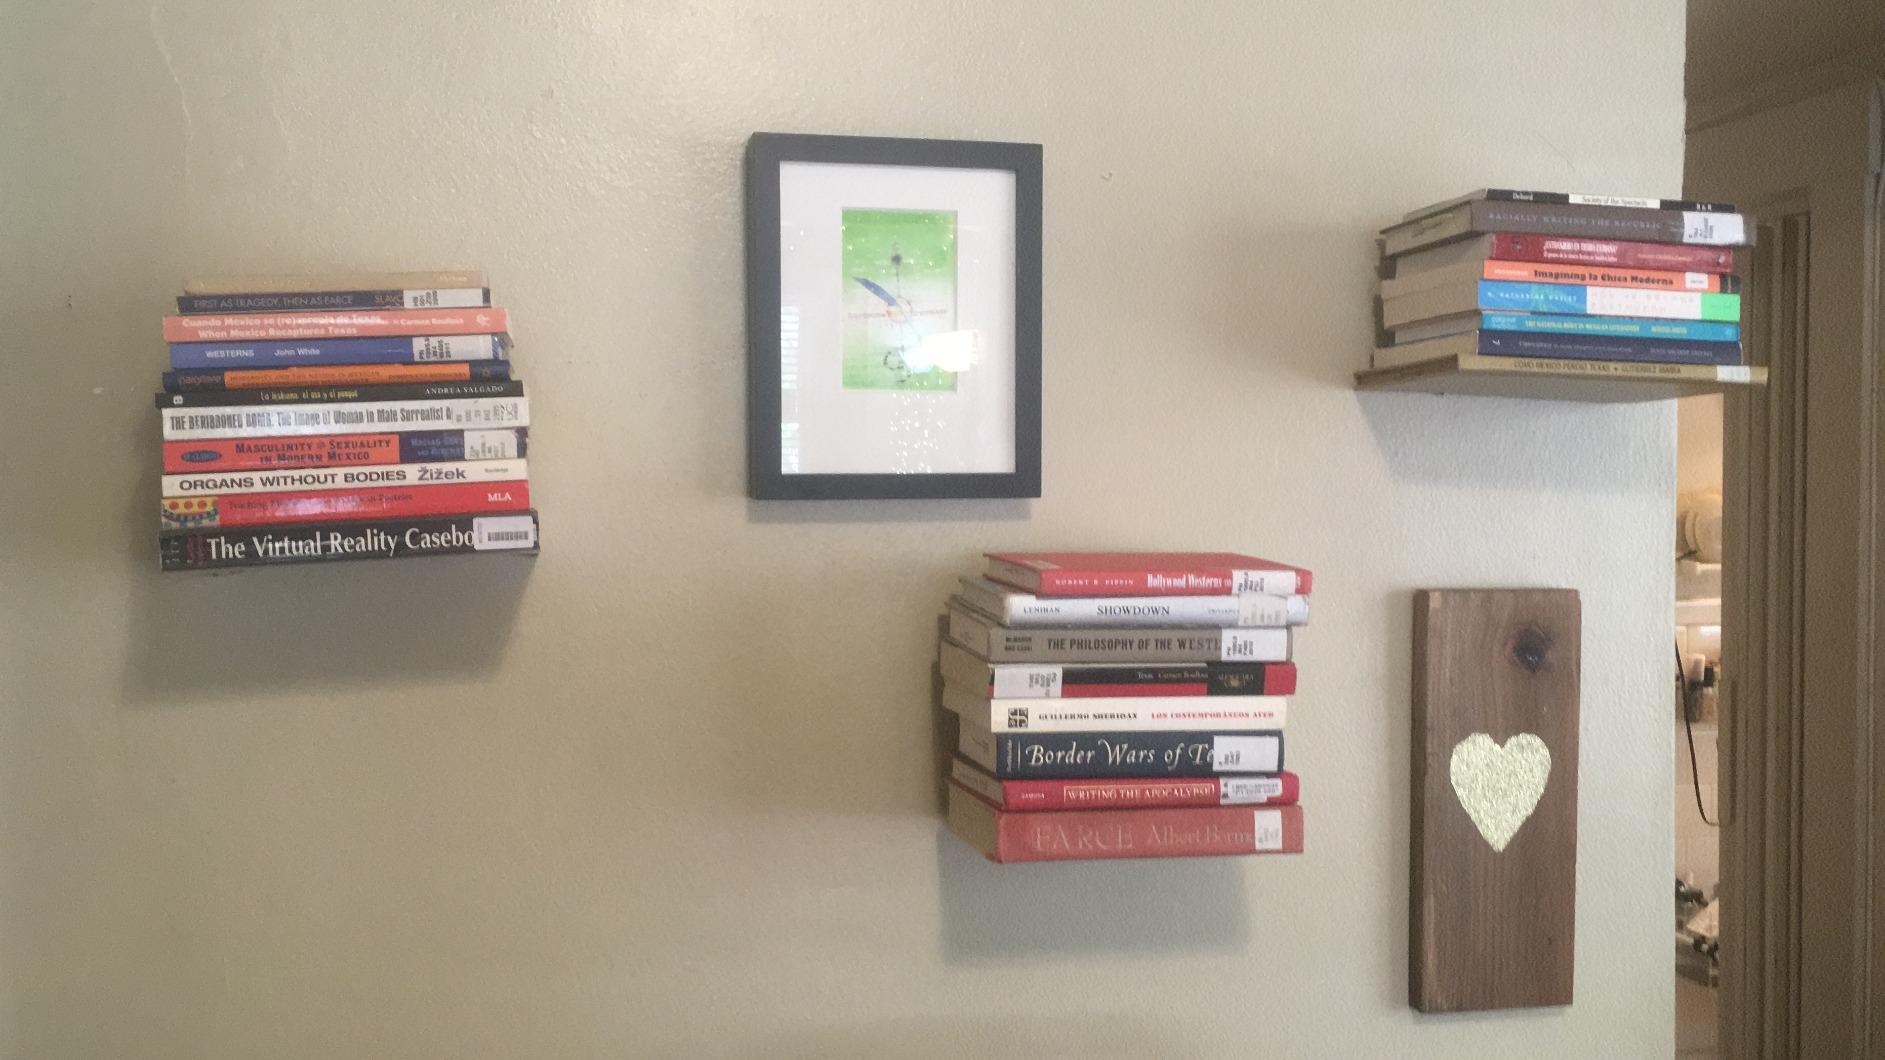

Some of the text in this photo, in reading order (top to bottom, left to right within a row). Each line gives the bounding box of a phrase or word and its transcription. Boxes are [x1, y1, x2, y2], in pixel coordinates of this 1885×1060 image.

[1534, 268, 1587, 283] Imagining
[1588, 271, 1598, 281] la
[1600, 273, 1628, 283] Chica
[1630, 275, 1674, 286] Moderna
[197, 326, 357, 339] When Mexico Recaptures Texas
[205, 347, 320, 359] WESTERNS John White
[424, 384, 504, 396] ANDREA SALGADO
[170, 415, 185, 431] THE
[366, 409, 376, 423] in
[377, 408, 398, 422] Male
[400, 407, 444, 422] Surrealist
[235, 441, 313, 454] MASCULINITY
[328, 438, 392, 450] SEXUALITY
[260, 451, 370, 464] IN MODERN MEXICO
[179, 466, 467, 491] ORGANS WITHOUT BODIES Žižek
[487, 492, 513, 502] MLA
[206, 535, 246, 560] The
[252, 531, 323, 558] Virtual
[326, 528, 399, 558] Reality
[404, 524, 474, 549] Casebo
[1147, 573, 1187, 592] Hollywood
[1187, 573, 1223, 589] Westerns
[1023, 604, 1171, 616] LENIHAN SHOWDOWN
[1047, 637, 1067, 651] THE
[1069, 637, 1134, 651] PHILOSOPHY
[1137, 637, 1149, 651] OF
[1154, 637, 1172, 651] THE
[1038, 713, 1090, 721] GUILLERMO
[1092, 712, 1138, 721] SHERIDAN
[1151, 711, 1168, 720] LOS
[1025, 740, 1096, 768] Border
[1097, 738, 1156, 767] Wars
[1163, 742, 1185, 771] of
[1067, 789, 1117, 801] WRITING
[1119, 788, 1139, 801] THE
[1035, 823, 1134, 851] FARCE
